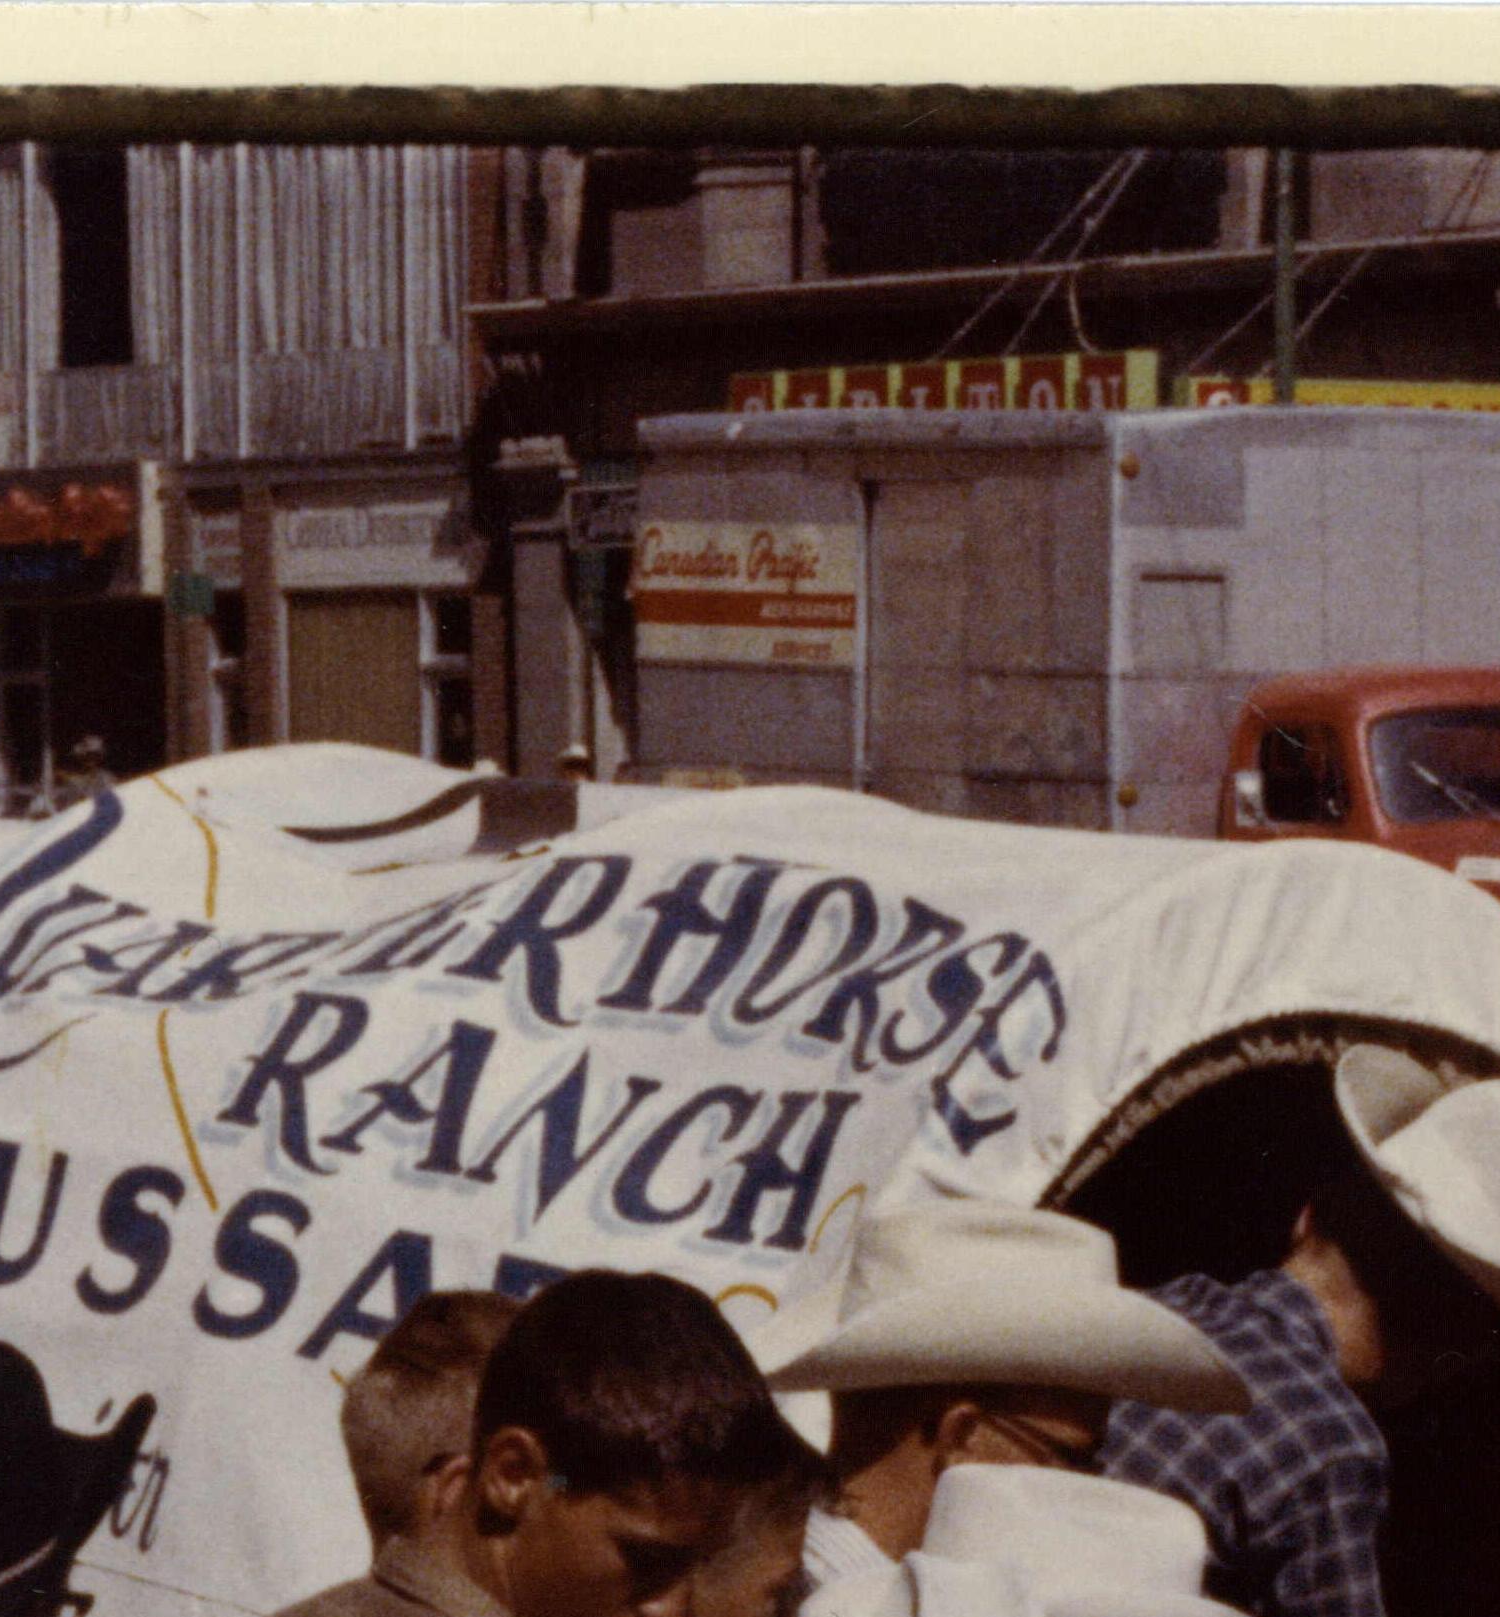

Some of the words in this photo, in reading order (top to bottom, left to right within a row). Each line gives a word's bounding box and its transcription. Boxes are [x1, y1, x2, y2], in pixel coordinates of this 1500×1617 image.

[634, 526, 739, 581] Canadian
[747, 529, 821, 596] Pacific
[215, 991, 862, 1253] RANCH
